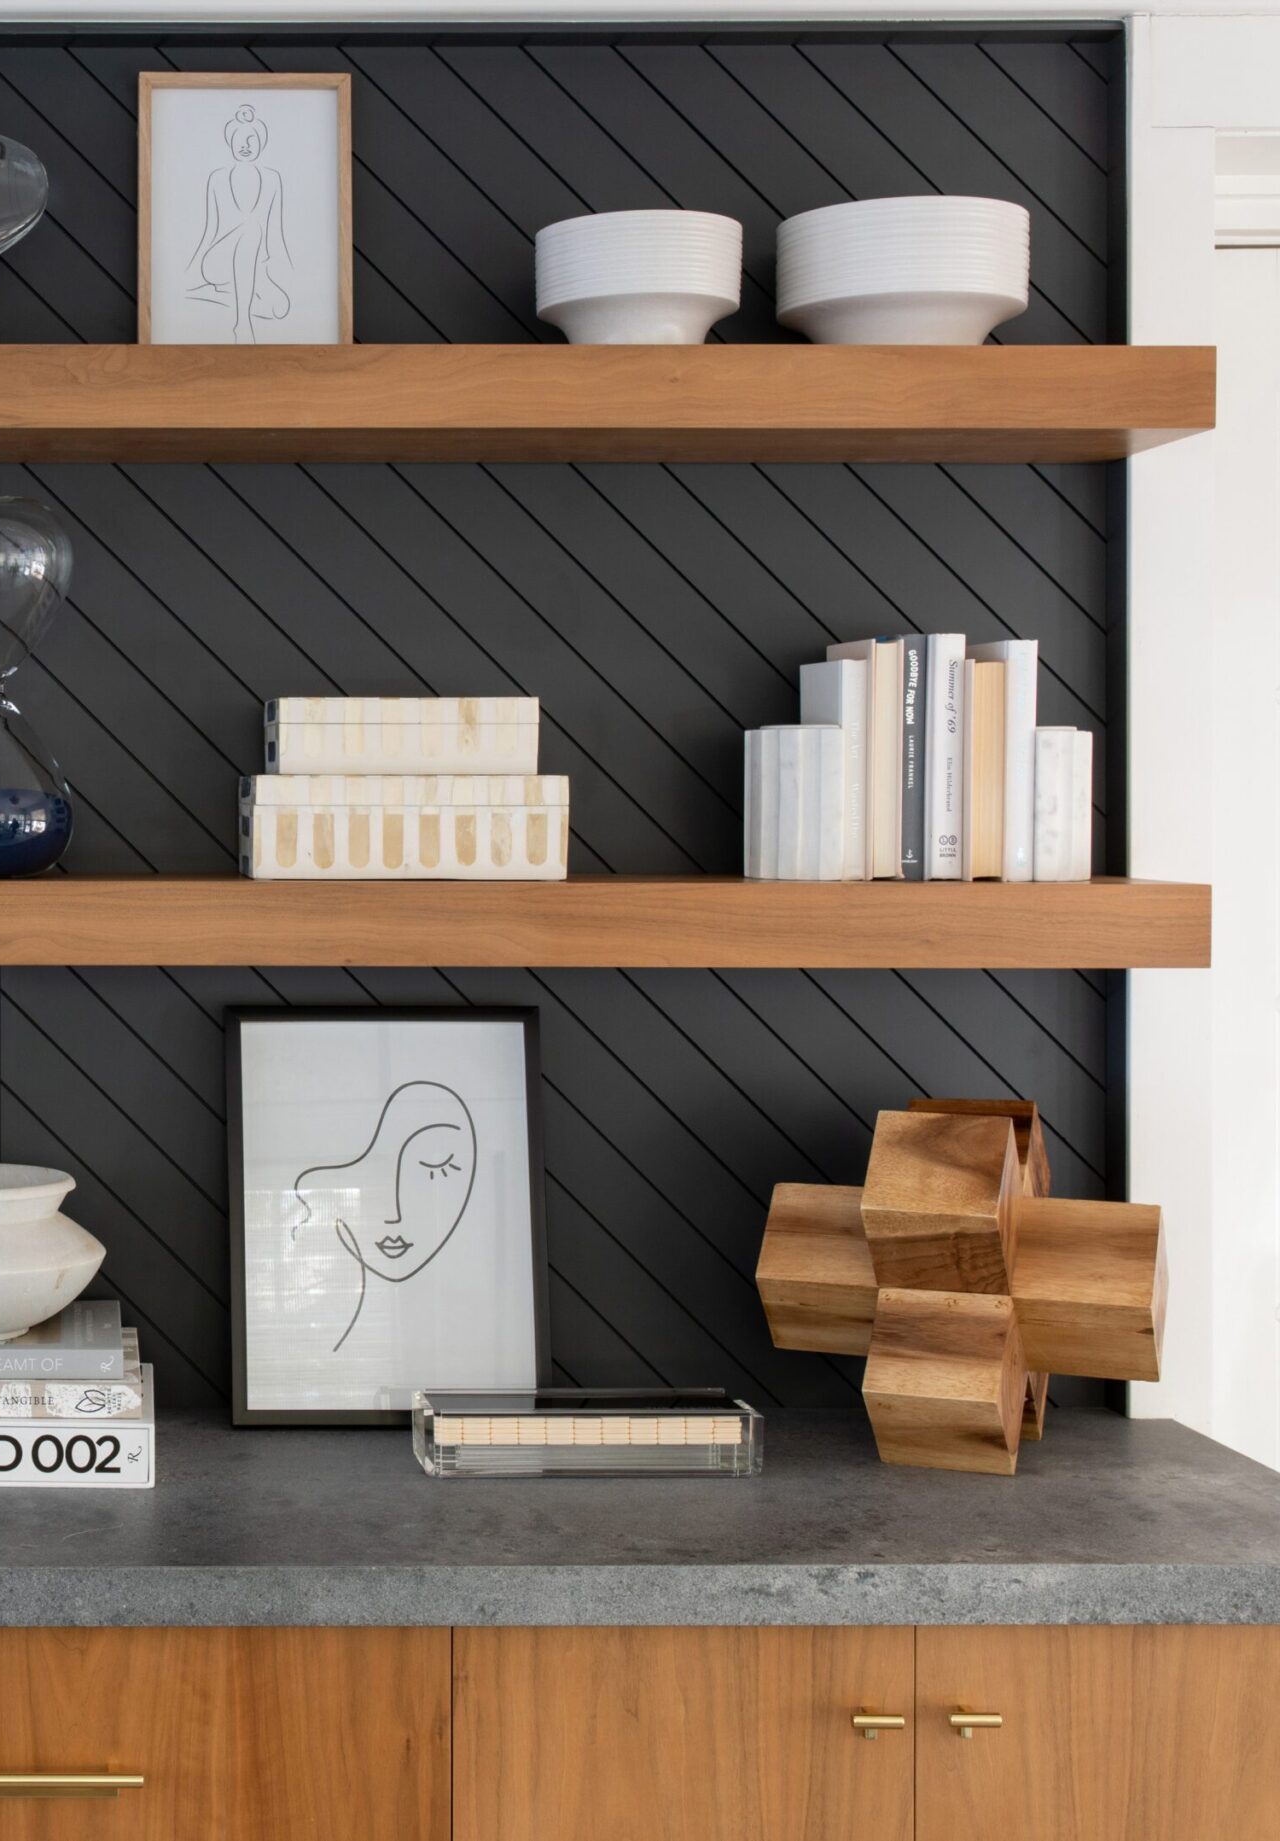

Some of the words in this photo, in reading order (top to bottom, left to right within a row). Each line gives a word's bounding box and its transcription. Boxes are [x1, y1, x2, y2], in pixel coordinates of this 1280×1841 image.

[907, 648, 918, 688] GOODBYE
[947, 659, 959, 701] Summer
[905, 689, 917, 706] FOR
[904, 706, 915, 725] NOW
[946, 702, 957, 715] of
[907, 735, 915, 759] LAURIE
[40, 1357, 64, 1372] OF
[31, 1434, 121, 1474] 002
